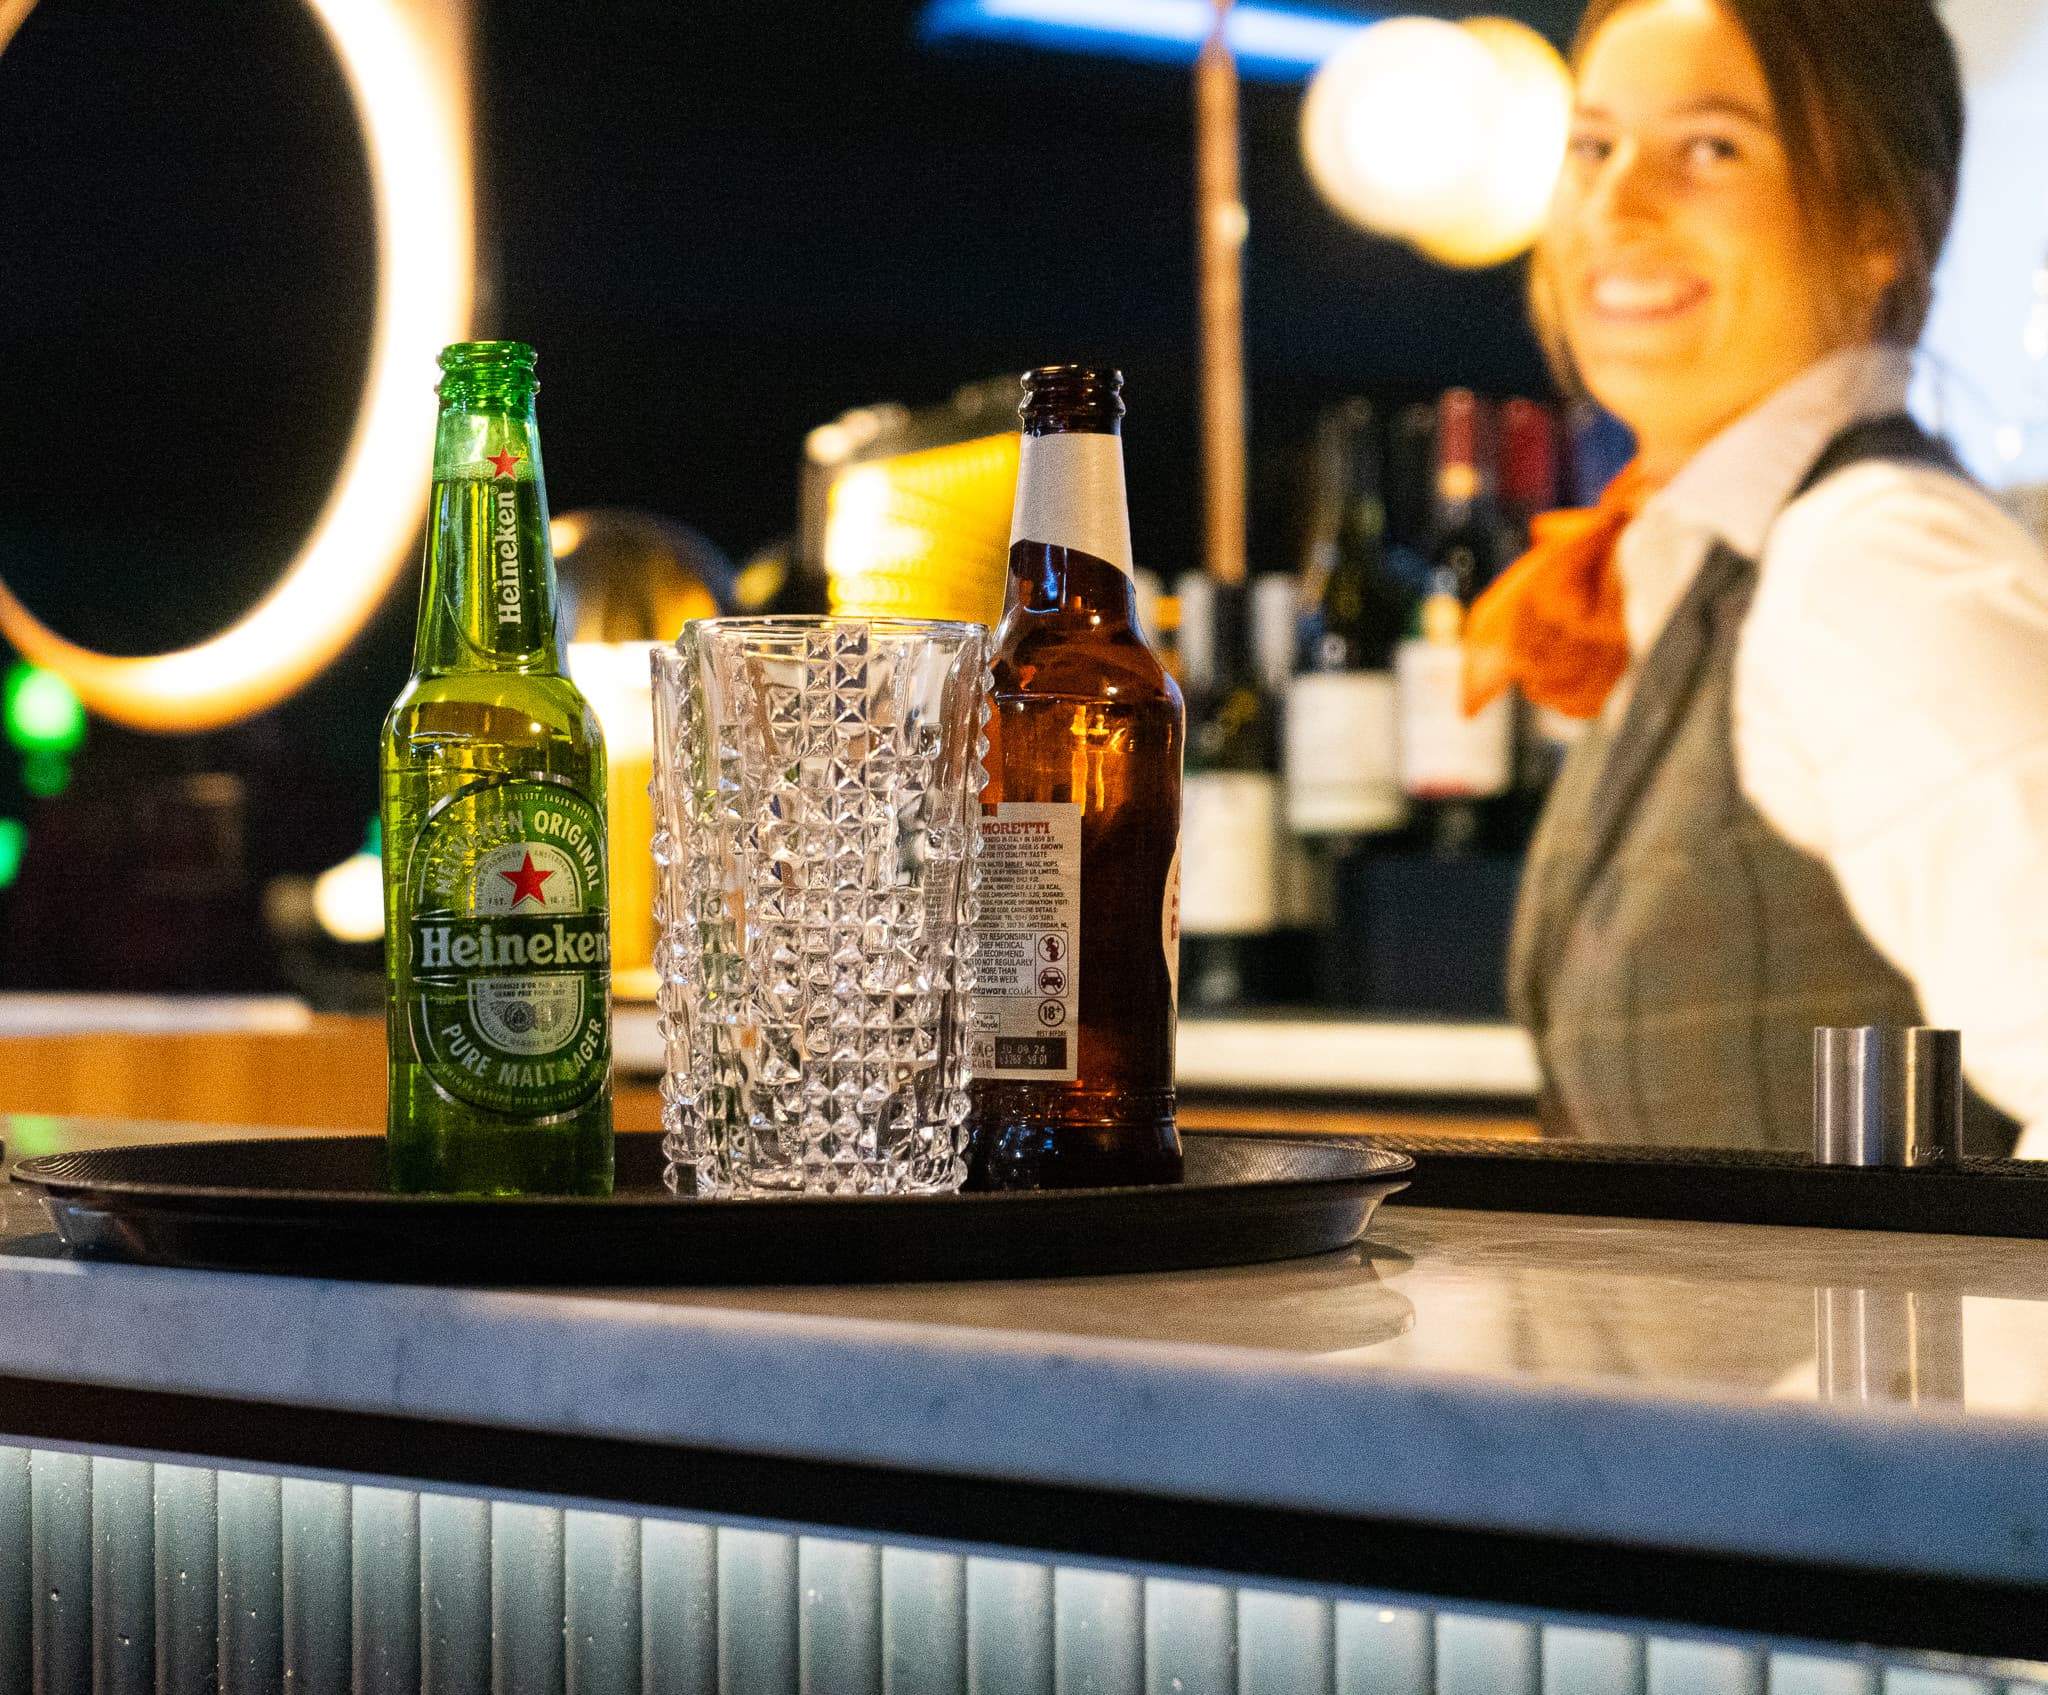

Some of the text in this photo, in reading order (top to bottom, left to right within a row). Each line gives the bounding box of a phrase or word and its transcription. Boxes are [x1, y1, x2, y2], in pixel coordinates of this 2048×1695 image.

[495, 490, 522, 625] Heineken
[981, 821, 1051, 835] MORETTI
[534, 809, 600, 892] ORIGINAL
[1040, 843, 1064, 851] KNOWN
[1005, 851, 1028, 859] QUALITY
[989, 932, 1034, 941] RESPONSIBLY
[420, 923, 608, 968] Heineken
[994, 941, 1025, 949] MEDICAL
[983, 950, 1025, 958] RECOMMEND
[995, 959, 1034, 967] REGULARLY
[981, 967, 1017, 975] MORE THAN
[987, 975, 998, 983] PER
[999, 975, 1019, 984] WEEK
[1042, 1005, 1061, 1021] 18+
[441, 1023, 492, 1078] PURE
[498, 1062, 557, 1088] MALT
[570, 1017, 602, 1075] AGER
